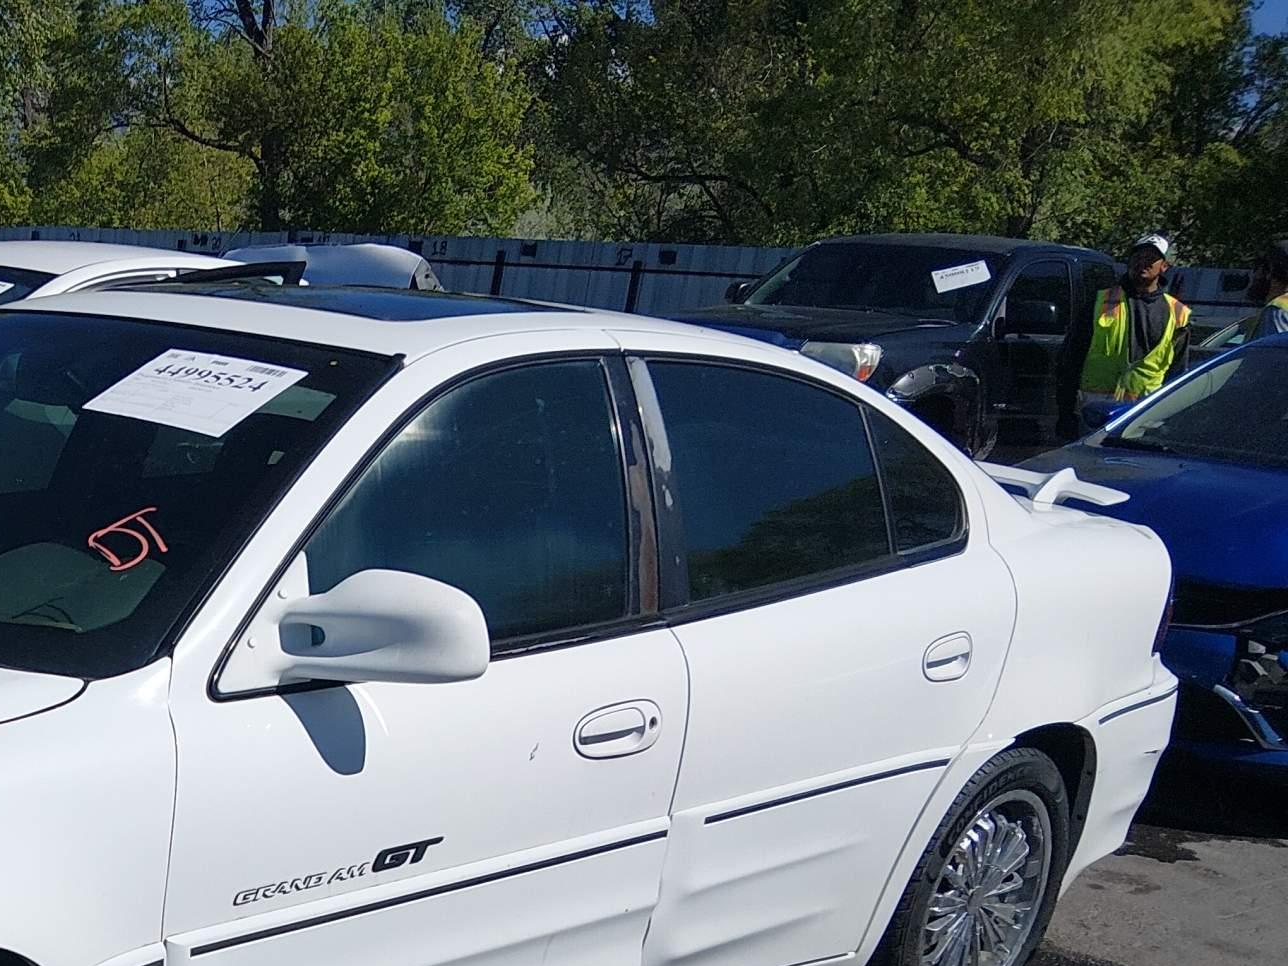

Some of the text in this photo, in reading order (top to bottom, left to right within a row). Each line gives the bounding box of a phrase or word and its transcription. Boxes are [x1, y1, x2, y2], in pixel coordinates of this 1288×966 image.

[431, 240, 448, 256] 18
[154, 363, 269, 392] 44995524
[232, 871, 328, 907] GRAND
[372, 836, 445, 873] GT
